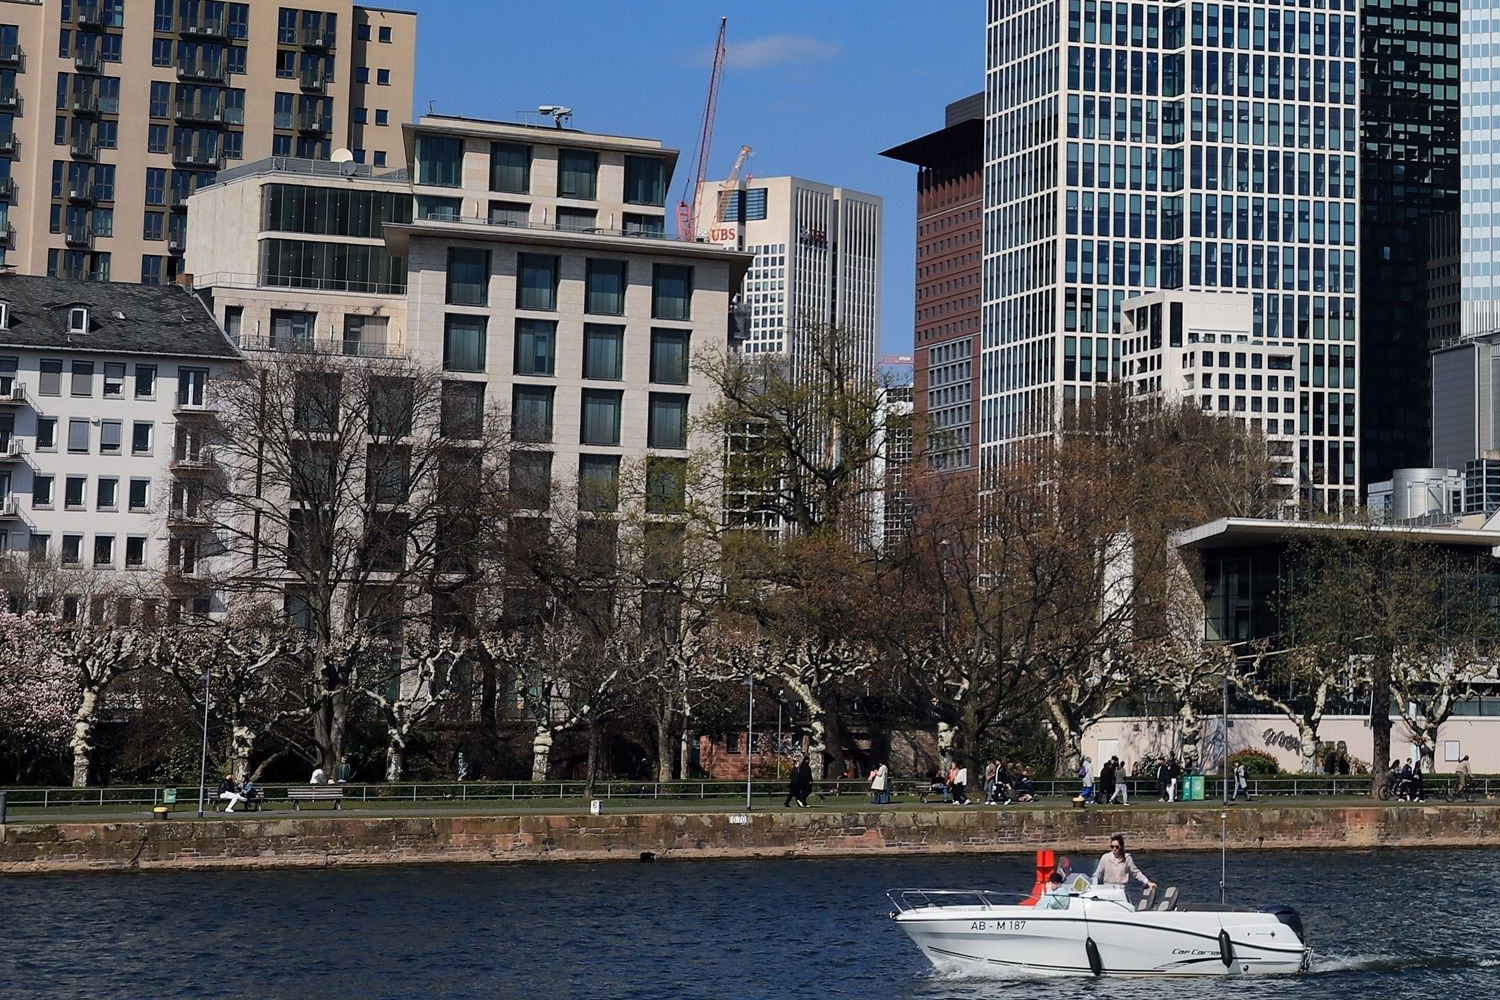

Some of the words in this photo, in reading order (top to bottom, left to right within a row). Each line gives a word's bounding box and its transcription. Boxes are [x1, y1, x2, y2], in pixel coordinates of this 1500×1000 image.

[711, 228, 736, 241] UBS
[970, 921, 986, 931] AB
[996, 921, 1006, 930] M
[1010, 920, 1026, 930] 187
